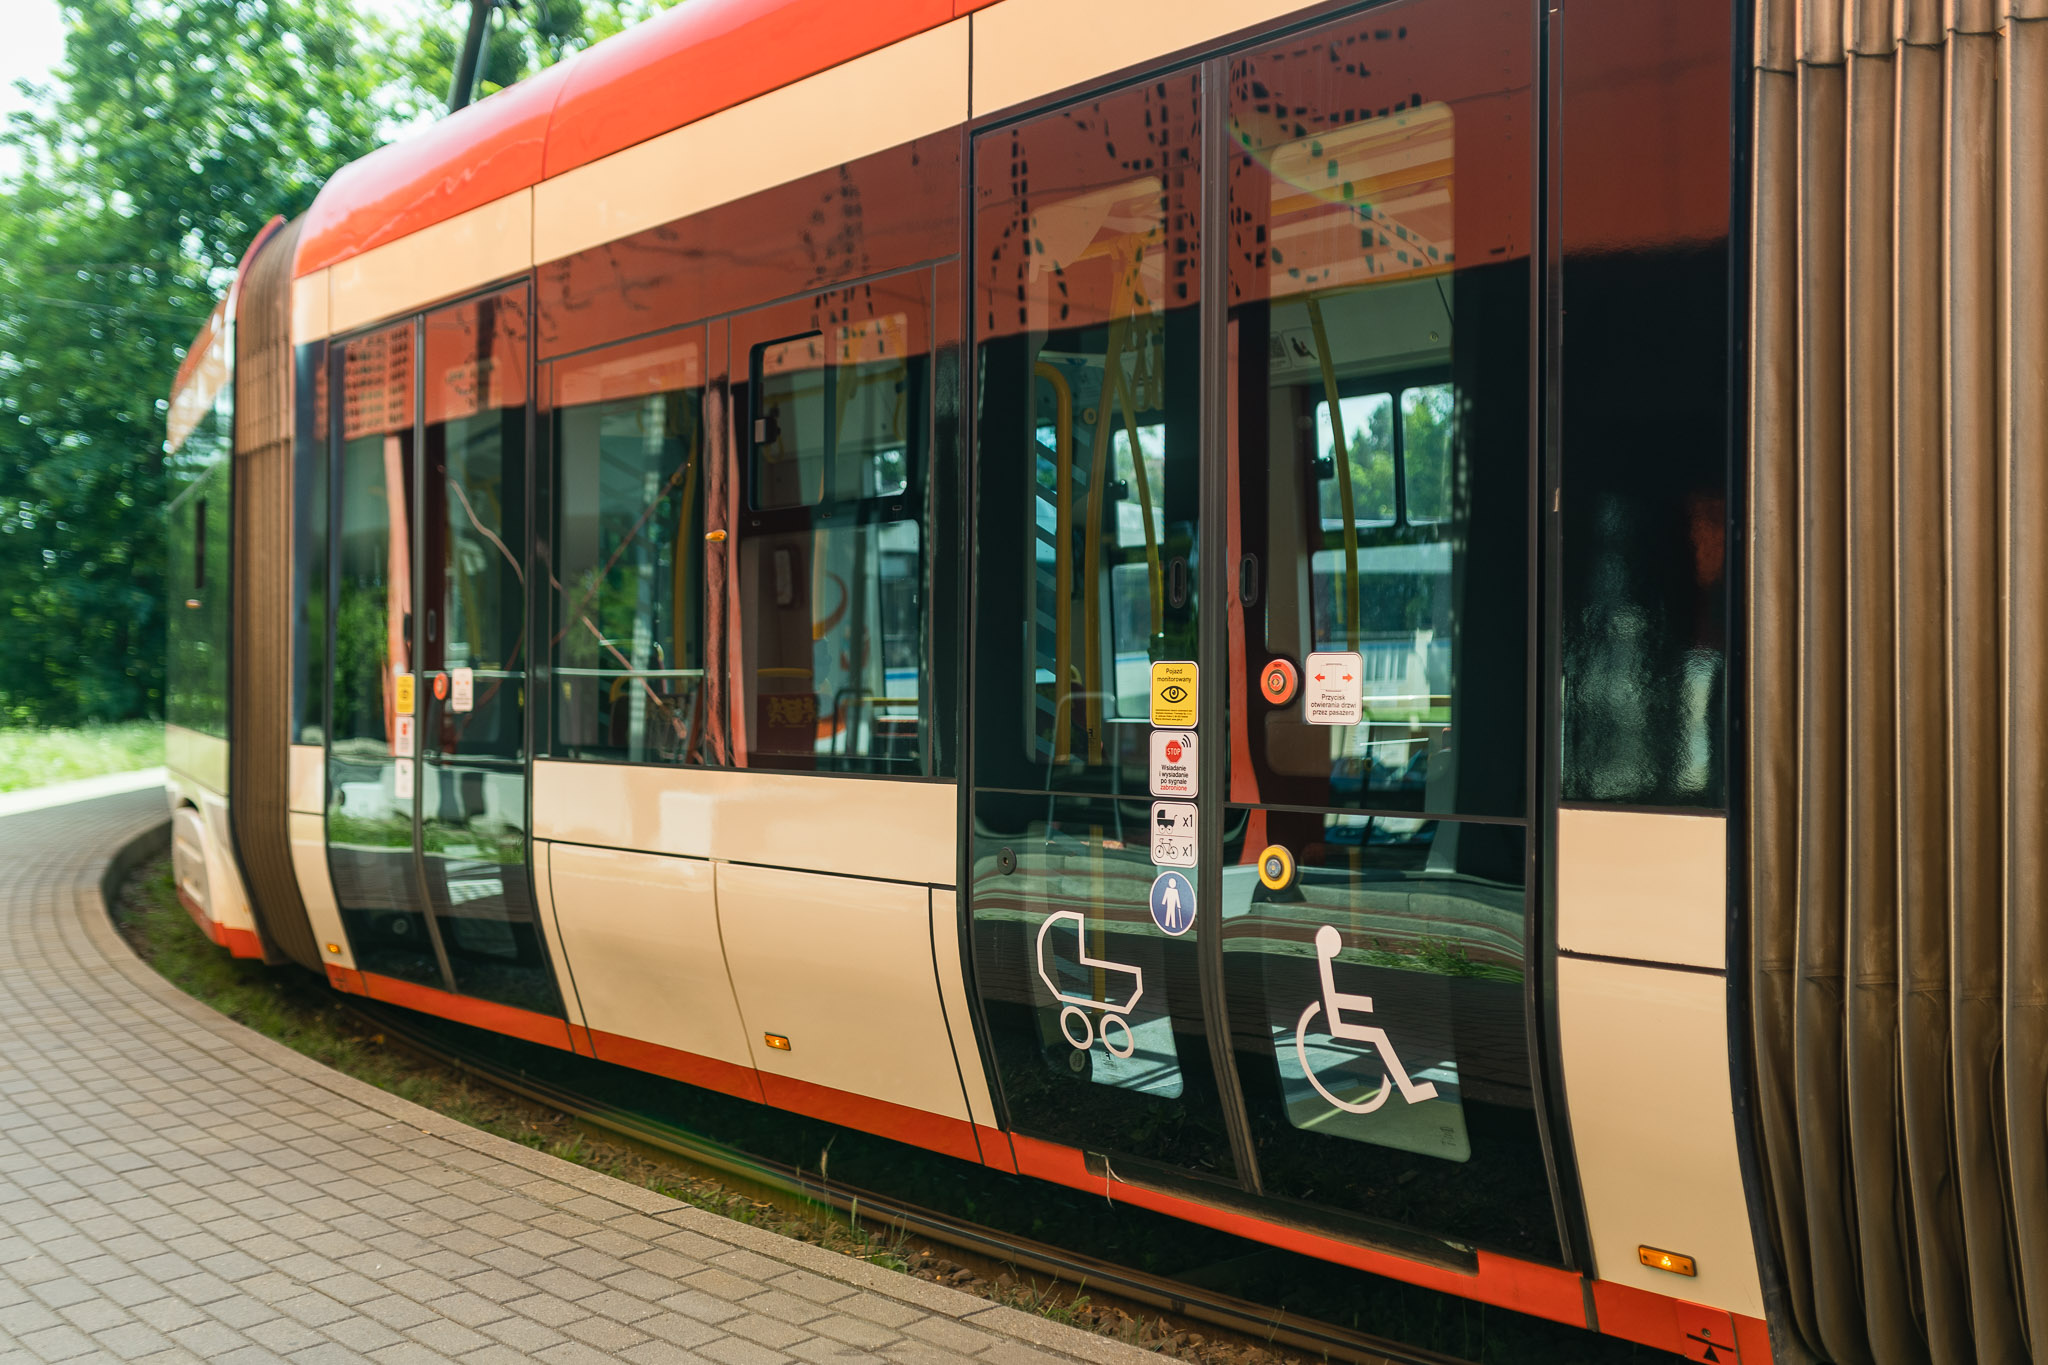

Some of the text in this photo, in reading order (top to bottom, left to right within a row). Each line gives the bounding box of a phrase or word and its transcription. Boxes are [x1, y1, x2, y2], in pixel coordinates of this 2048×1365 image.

[1167, 747, 1181, 756] STOP
[1182, 814, 1193, 827] x1
[1182, 844, 1192, 857] x1
